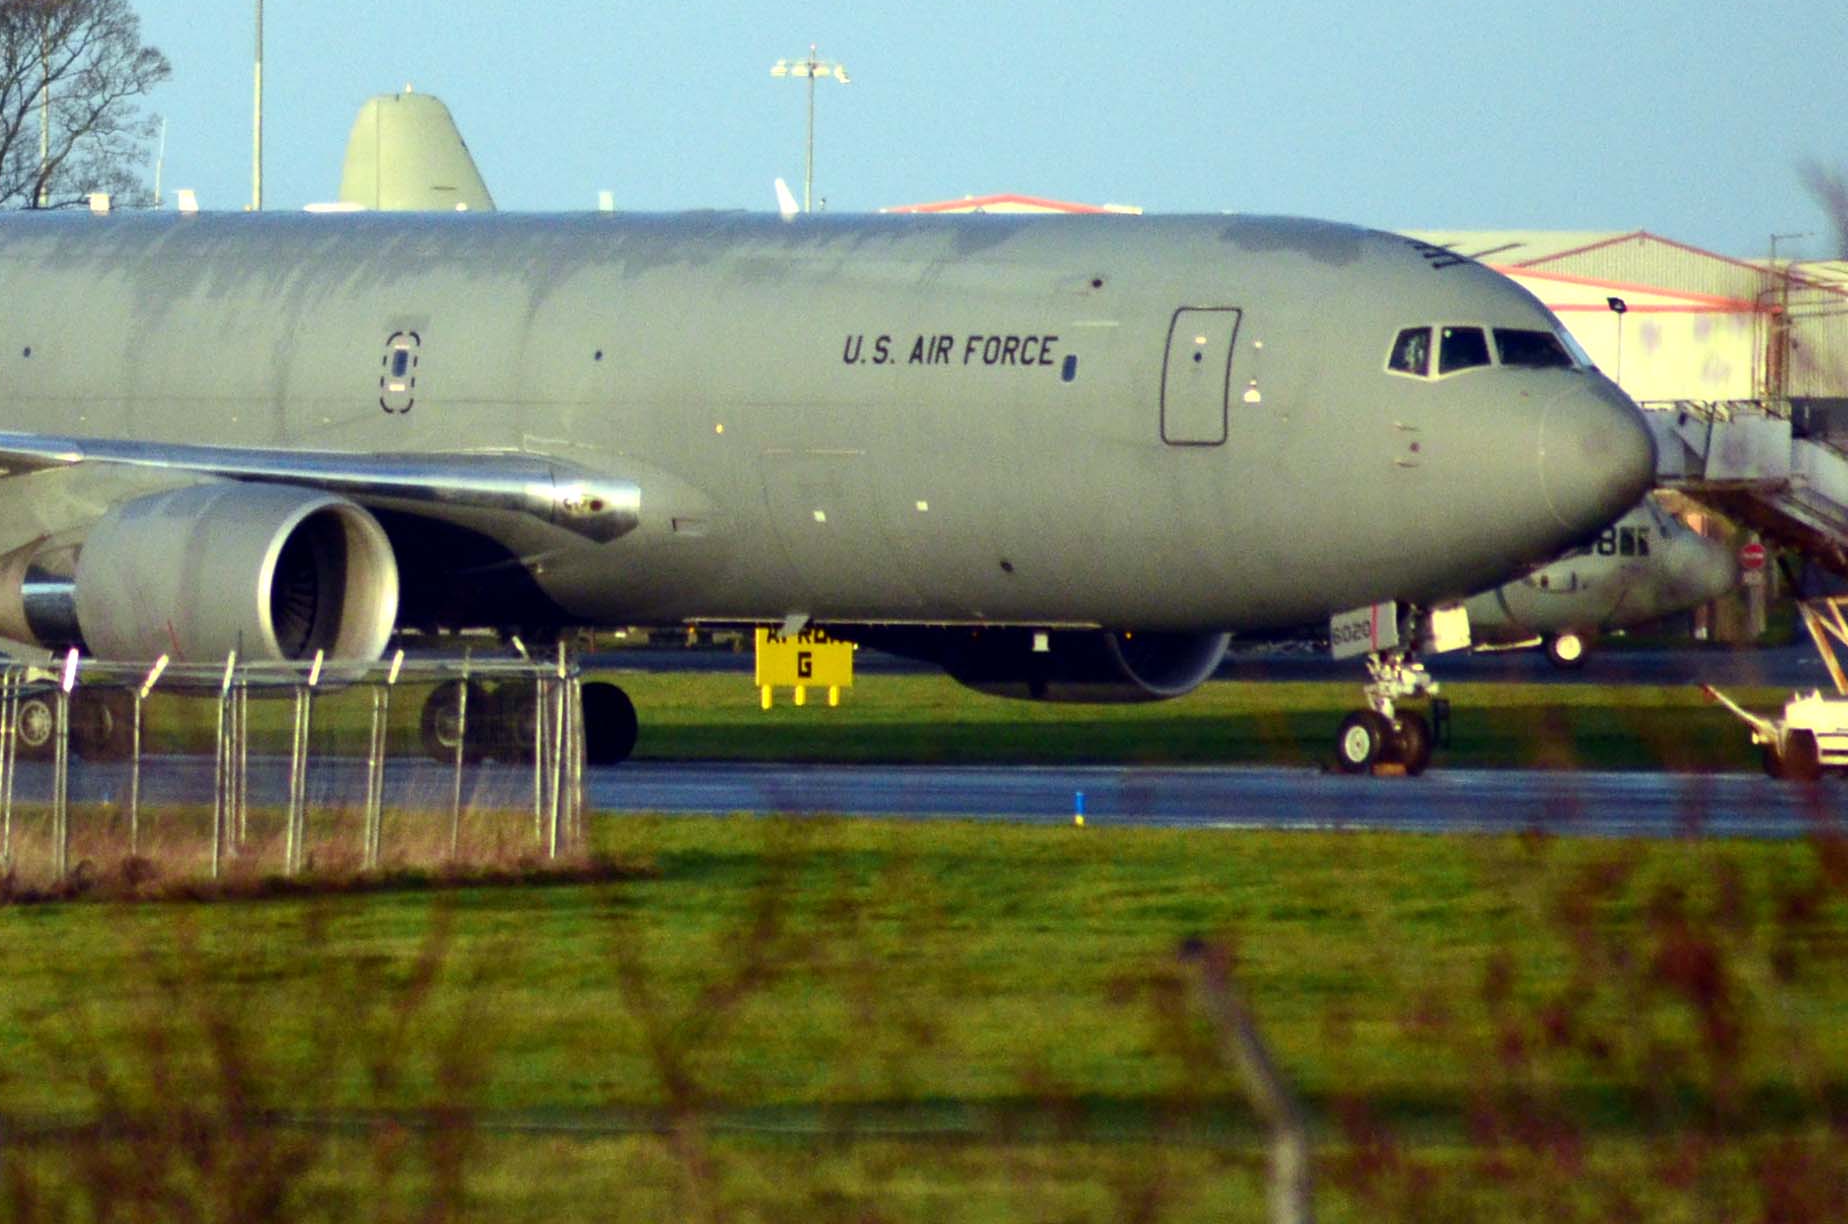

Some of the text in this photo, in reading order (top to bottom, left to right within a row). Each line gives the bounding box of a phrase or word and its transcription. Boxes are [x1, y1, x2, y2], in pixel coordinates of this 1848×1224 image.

[843, 335, 1059, 366] U.S. AIR FORCE
[797, 651, 812, 678] G
